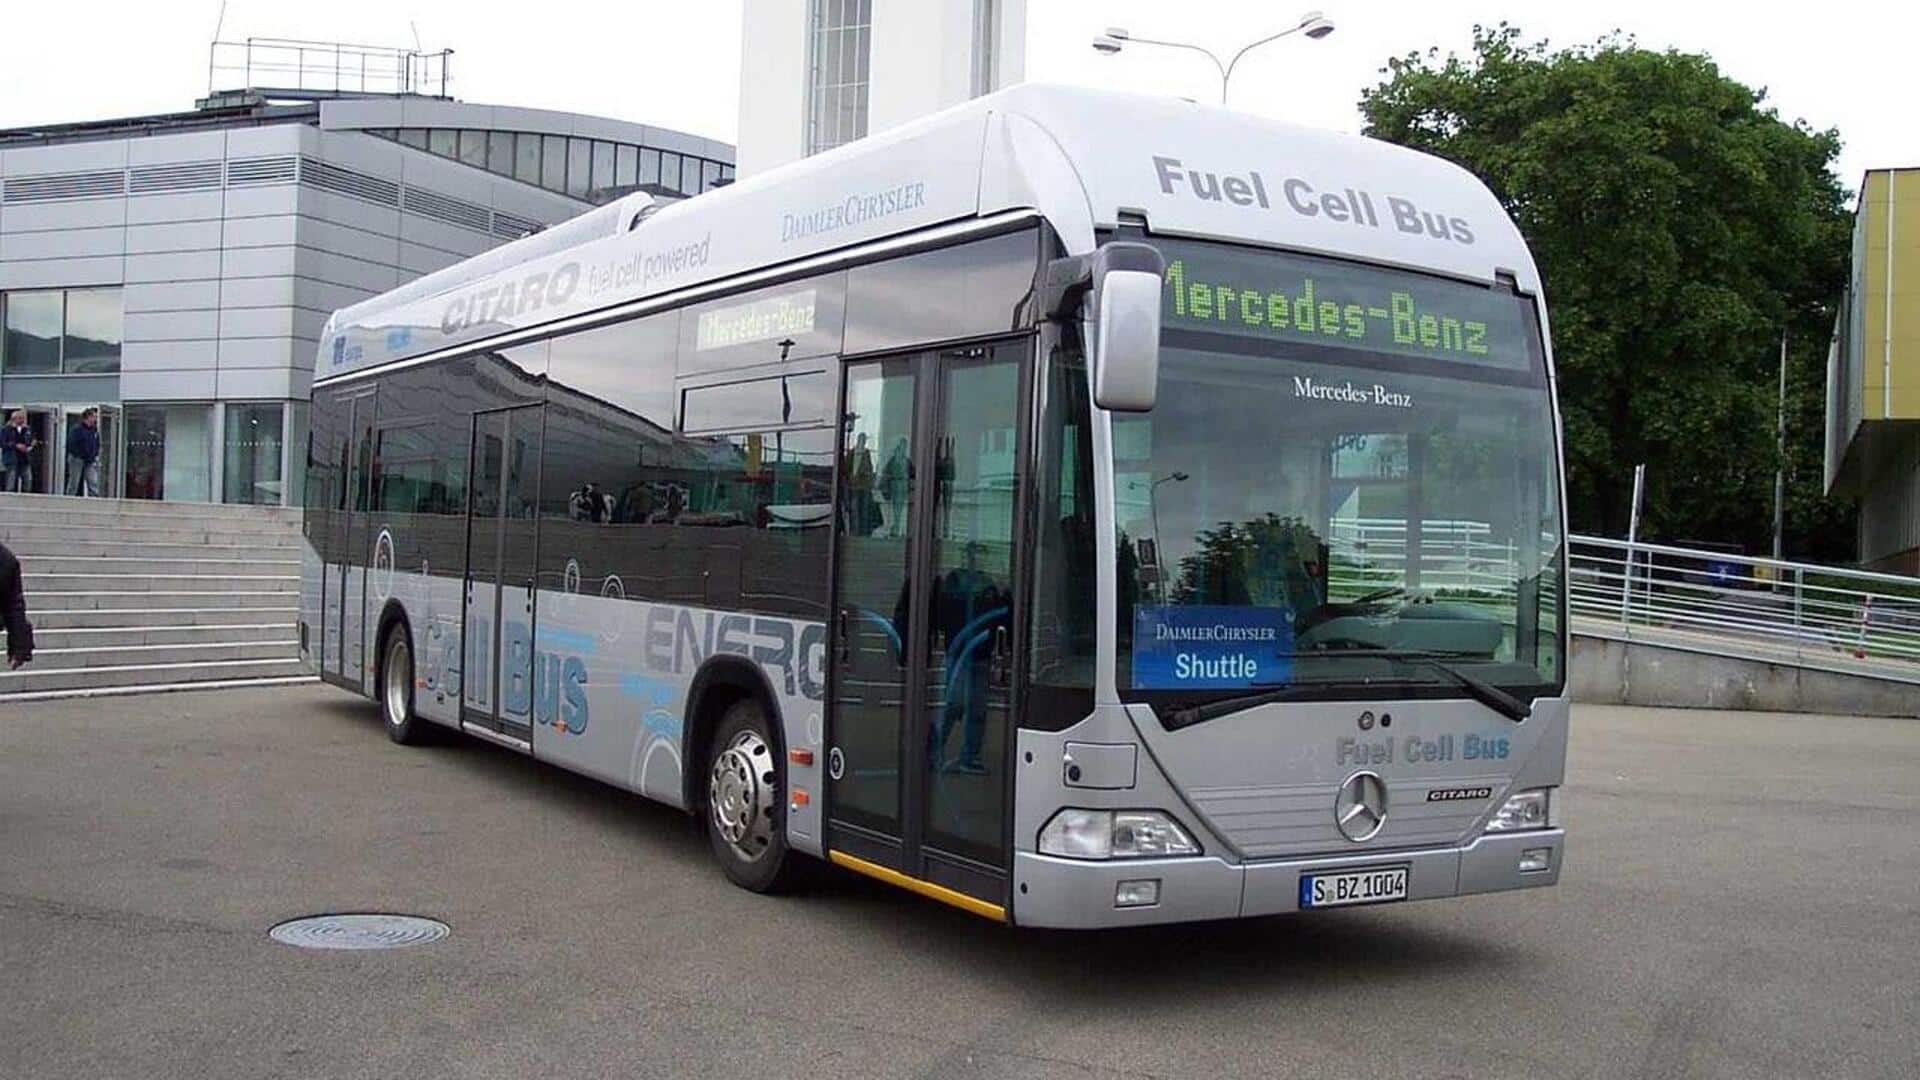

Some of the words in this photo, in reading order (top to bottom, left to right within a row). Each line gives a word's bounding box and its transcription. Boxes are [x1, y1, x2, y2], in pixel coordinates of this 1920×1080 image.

[1152, 155, 1270, 209] Fuel
[1283, 178, 1379, 228] Cell
[1387, 196, 1476, 245] Bus
[588, 261, 614, 294] fuel
[617, 253, 641, 288] cell
[644, 232, 712, 288] powered
[441, 261, 581, 336] CITARO
[1292, 375, 1413, 409] Mercedes-Benz
[1175, 653, 1258, 679] Shuttle
[1336, 736, 1395, 767] Fuel
[1405, 735, 1454, 764] Cell
[1463, 733, 1511, 761] Bus
[1429, 788, 1490, 801] CITARO
[1315, 879, 1326, 902] S
[1337, 877, 1359, 900] BZ
[1362, 873, 1404, 898] 1004
